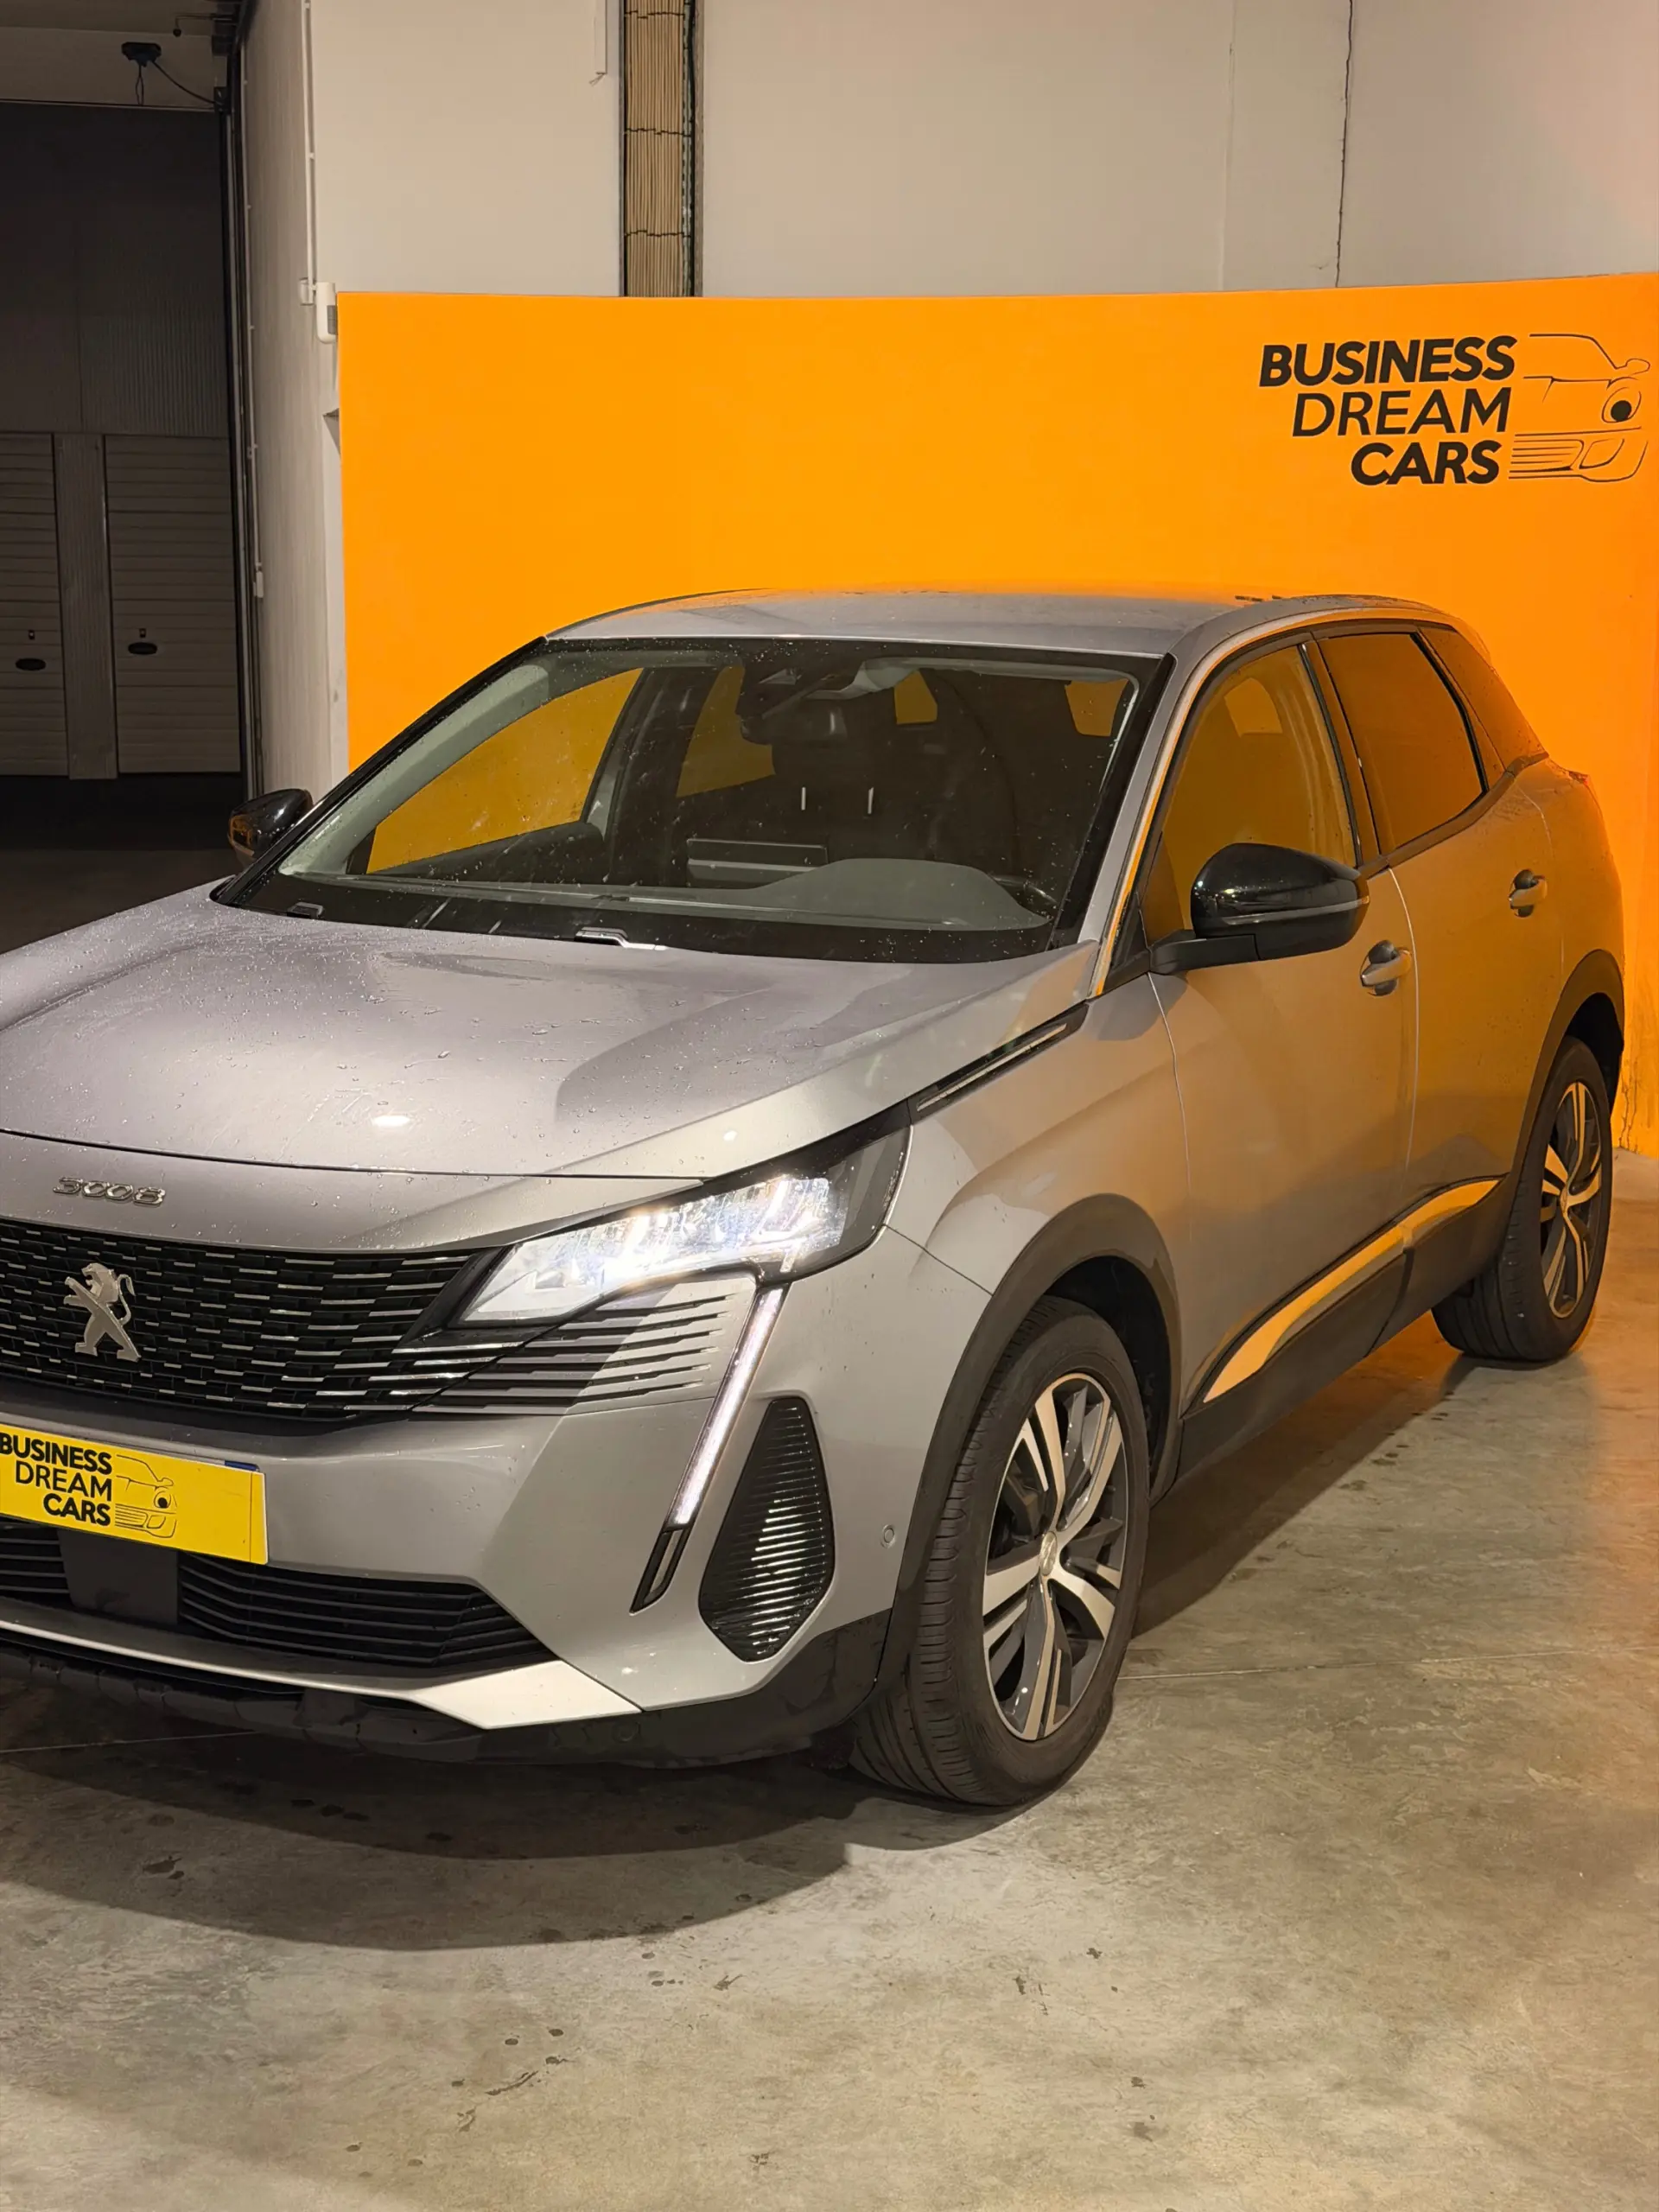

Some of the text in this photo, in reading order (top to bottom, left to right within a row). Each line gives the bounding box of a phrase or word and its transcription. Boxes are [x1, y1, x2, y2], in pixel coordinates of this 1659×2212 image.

[1259, 335, 1517, 387] BUSINESS
[1292, 386, 1511, 436] DREAM
[1351, 440, 1502, 486] CARS
[0, 1432, 111, 1475] BUSINESS
[16, 1460, 111, 1502] DREAM
[43, 1492, 111, 1526] CARS
